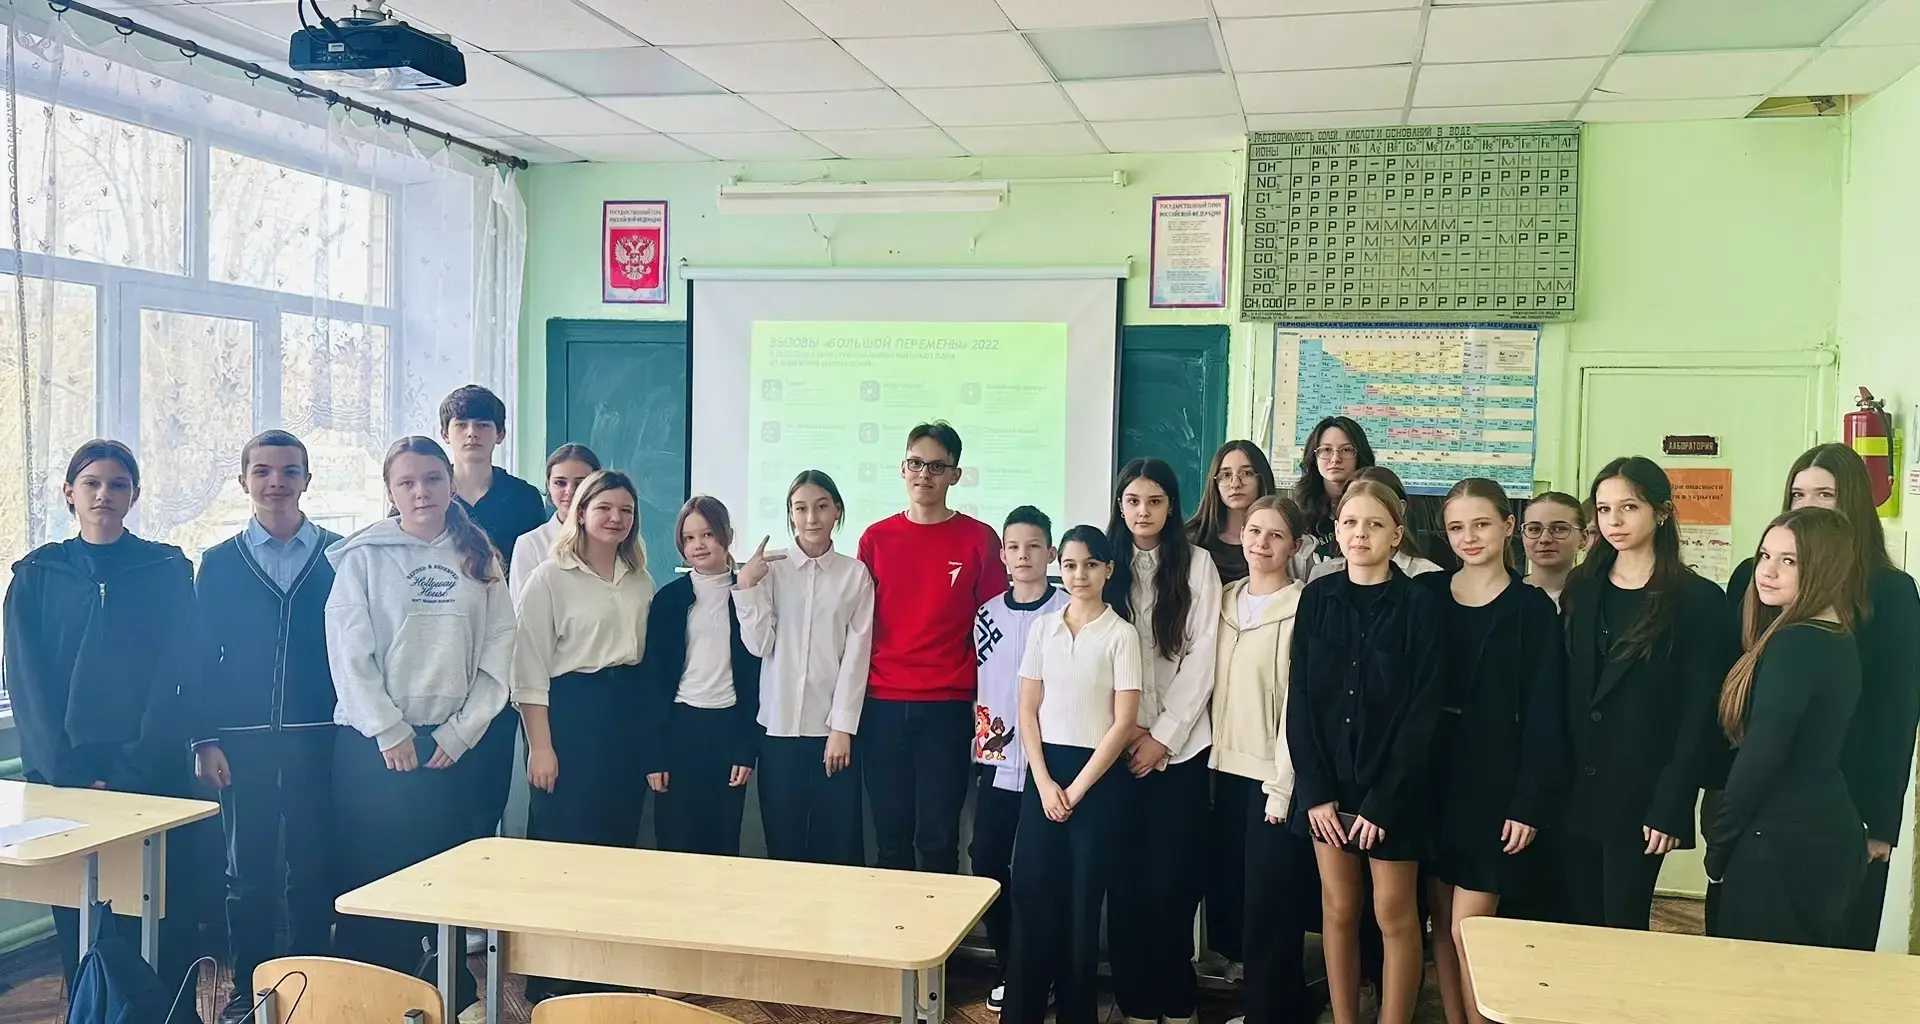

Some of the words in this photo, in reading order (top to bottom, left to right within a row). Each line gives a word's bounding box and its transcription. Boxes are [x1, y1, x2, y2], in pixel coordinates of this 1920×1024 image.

[1254, 132, 1314, 143] РАСТВОРИМОСТЬ
[1345, 129, 1374, 139] КИСЛОТ
[1376, 128, 1382, 138] И
[1385, 125, 1432, 138] ОСНОВАНИЙ
[1437, 127, 1443, 136] В
[1449, 126, 1471, 136] ВОДЕ
[1255, 146, 1279, 157] ИОНЫ
[1278, 321, 1337, 329] ПЕРИОДИЧЕСКАЯ
[769, 337, 819, 348] ВЫЗОВЫ
[971, 339, 999, 350] 2022
[1669, 441, 1714, 450] ЛАБОРАТОРИЯ
[1688, 493, 1724, 502] укрытие!
[433, 564, 460, 581] RESERVED
[410, 576, 457, 591] Holloway
[417, 586, 449, 598] House
